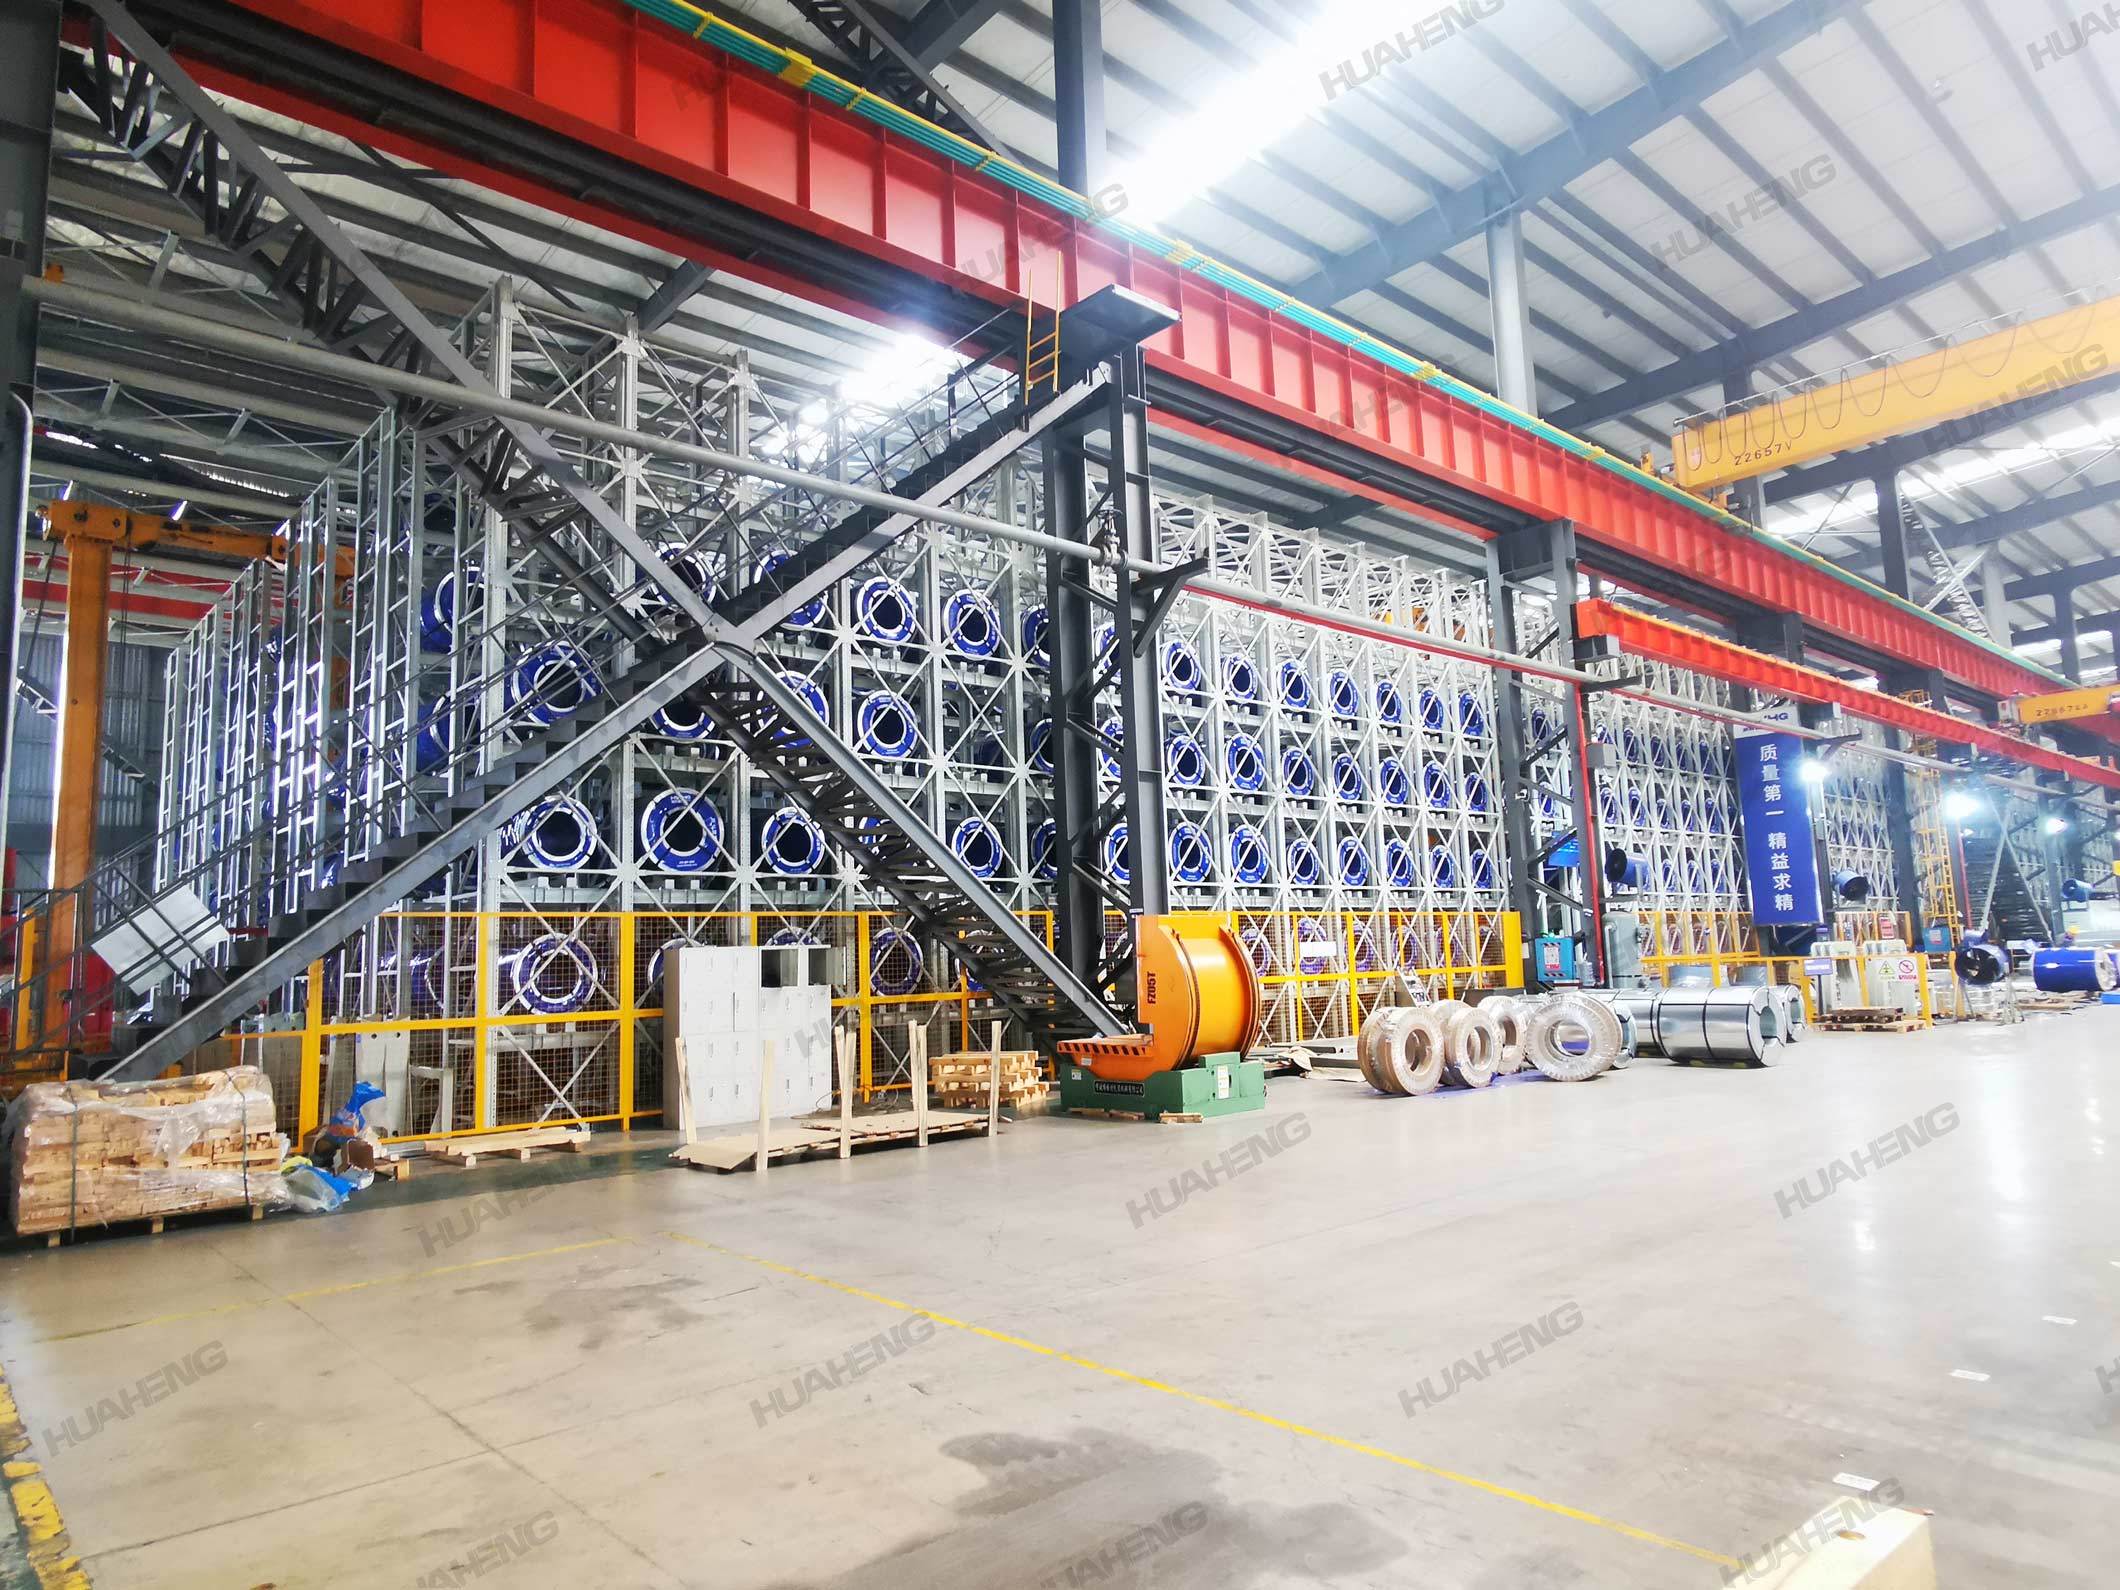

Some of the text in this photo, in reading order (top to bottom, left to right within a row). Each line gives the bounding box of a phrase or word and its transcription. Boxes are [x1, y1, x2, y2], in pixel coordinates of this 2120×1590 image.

[1760, 744, 1794, 911] 质量第一 精益求精
